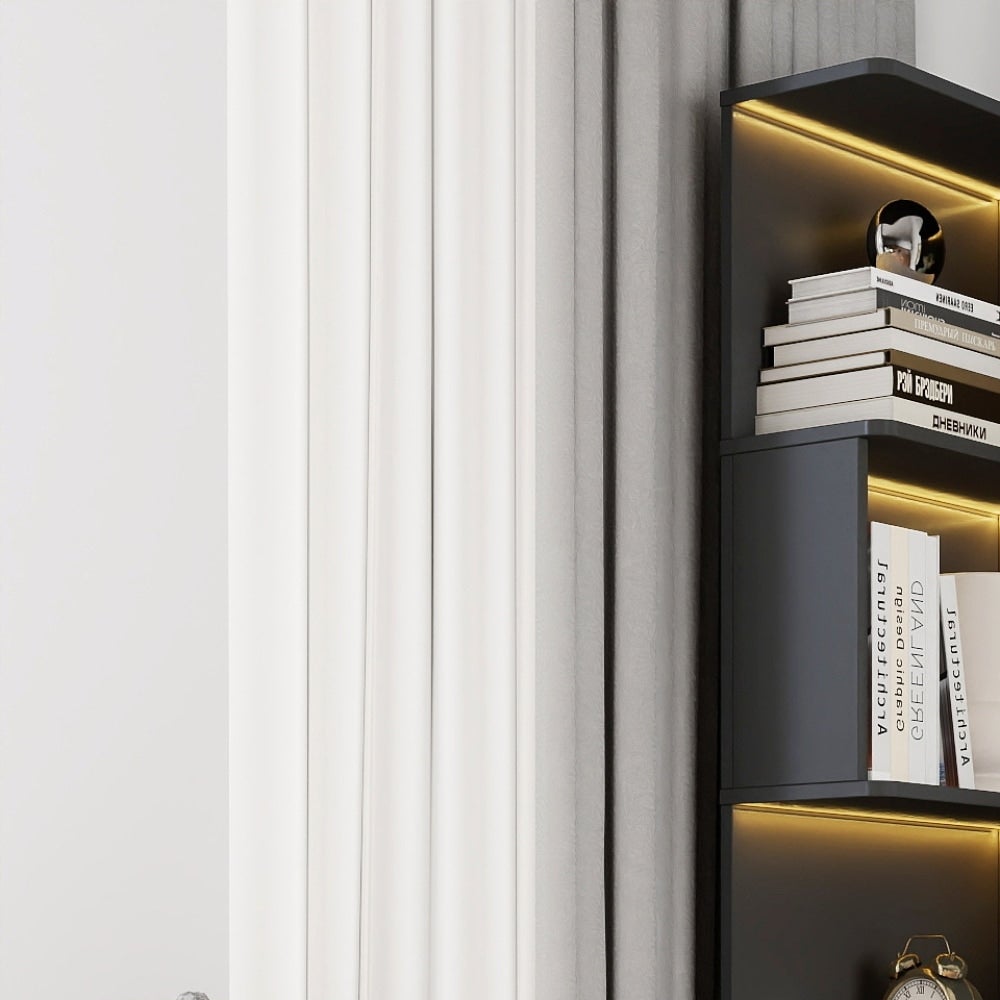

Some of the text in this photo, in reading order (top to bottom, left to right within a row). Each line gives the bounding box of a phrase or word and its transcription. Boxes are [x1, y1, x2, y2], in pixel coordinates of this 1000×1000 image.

[897, 369, 953, 405] РЭЙ БРЭДБЕРИ
[932, 415, 987, 440] ДНЕВНИКИ
[916, 986, 925, 994] XII
